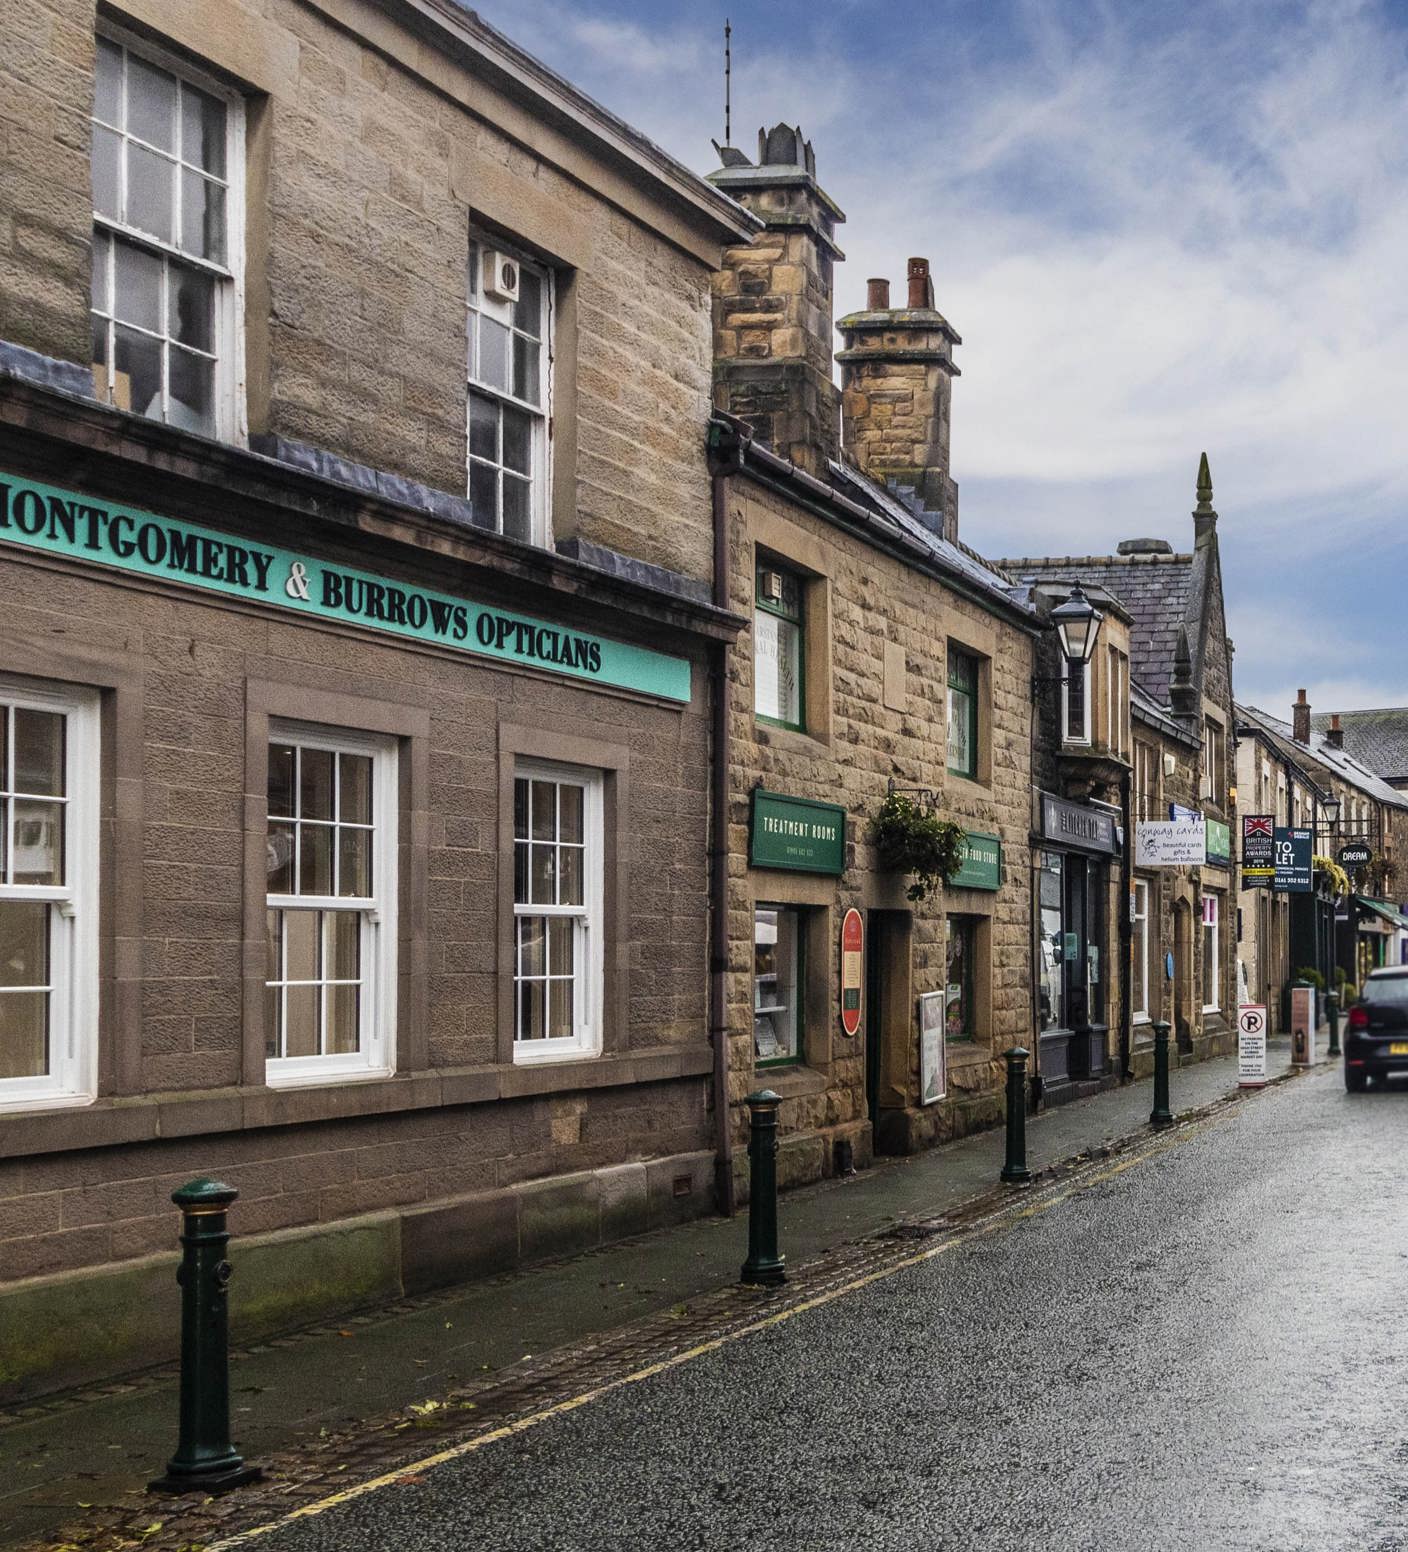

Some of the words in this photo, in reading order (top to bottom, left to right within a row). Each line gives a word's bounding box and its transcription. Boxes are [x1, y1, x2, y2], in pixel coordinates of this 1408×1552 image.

[285, 561, 311, 601] &
[320, 569, 468, 640] BURROWS
[476, 612, 601, 673] OPTICIANS
[763, 817, 808, 837] TREATMENT
[812, 824, 836, 840] ROOMS
[1176, 824, 1204, 835] cards
[1275, 841, 1292, 853] TO
[1275, 853, 1295, 865] LET
[1342, 851, 1368, 861] DREAM
